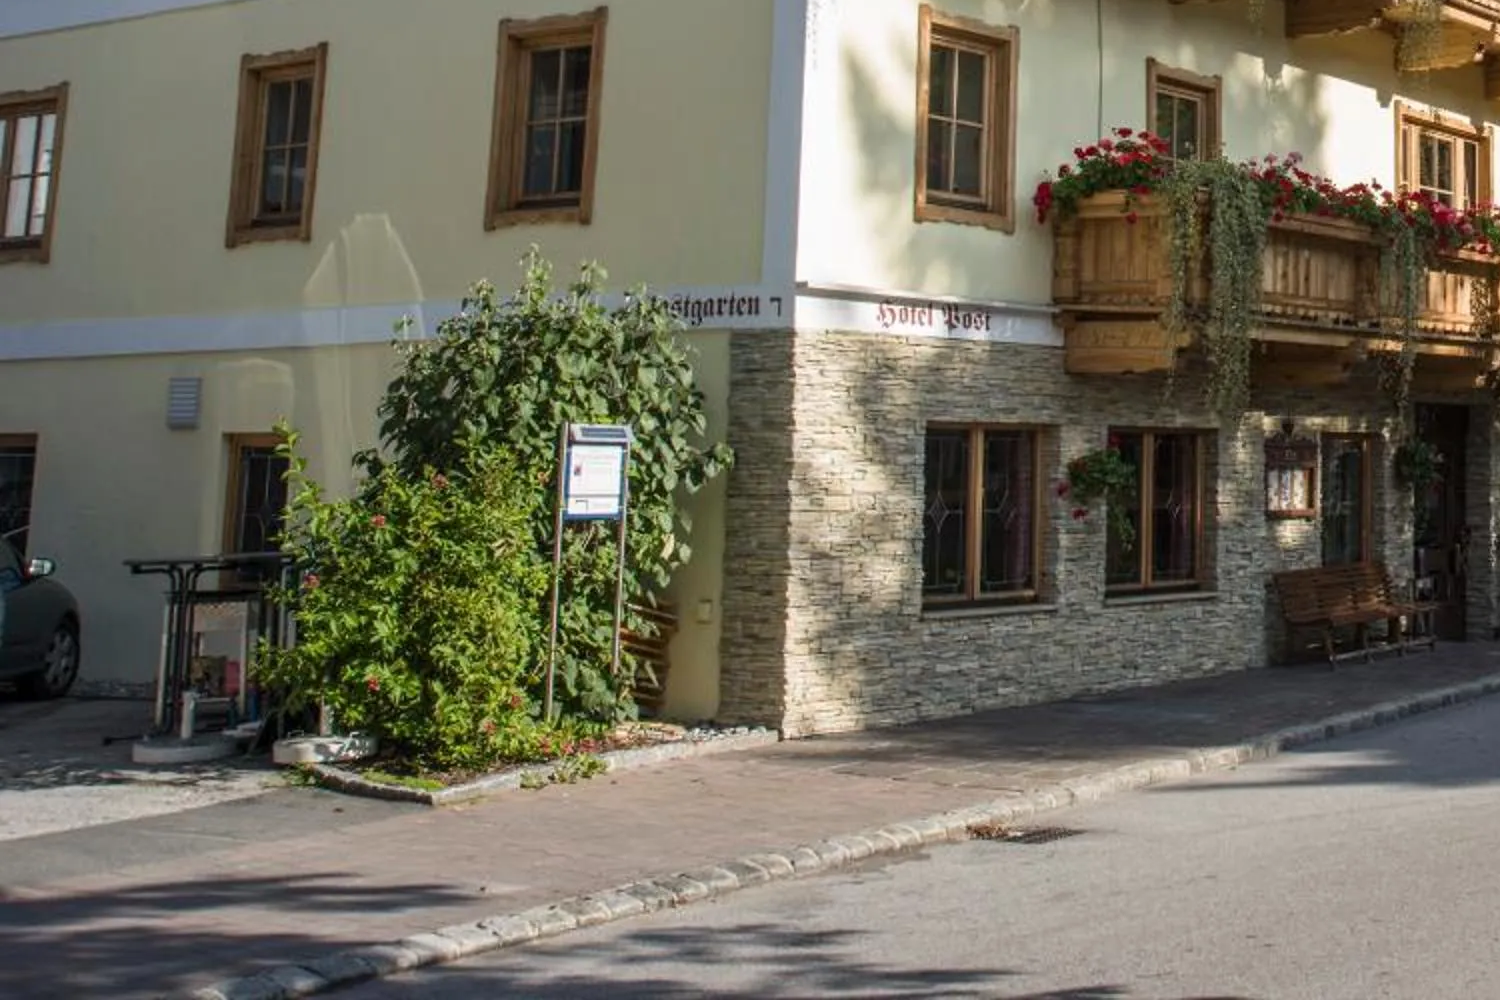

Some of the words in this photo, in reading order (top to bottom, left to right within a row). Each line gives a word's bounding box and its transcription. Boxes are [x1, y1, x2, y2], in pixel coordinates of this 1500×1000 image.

[638, 289, 760, 326] ostgarten
[876, 300, 933, 328] Hotel
[942, 303, 992, 332] Post
